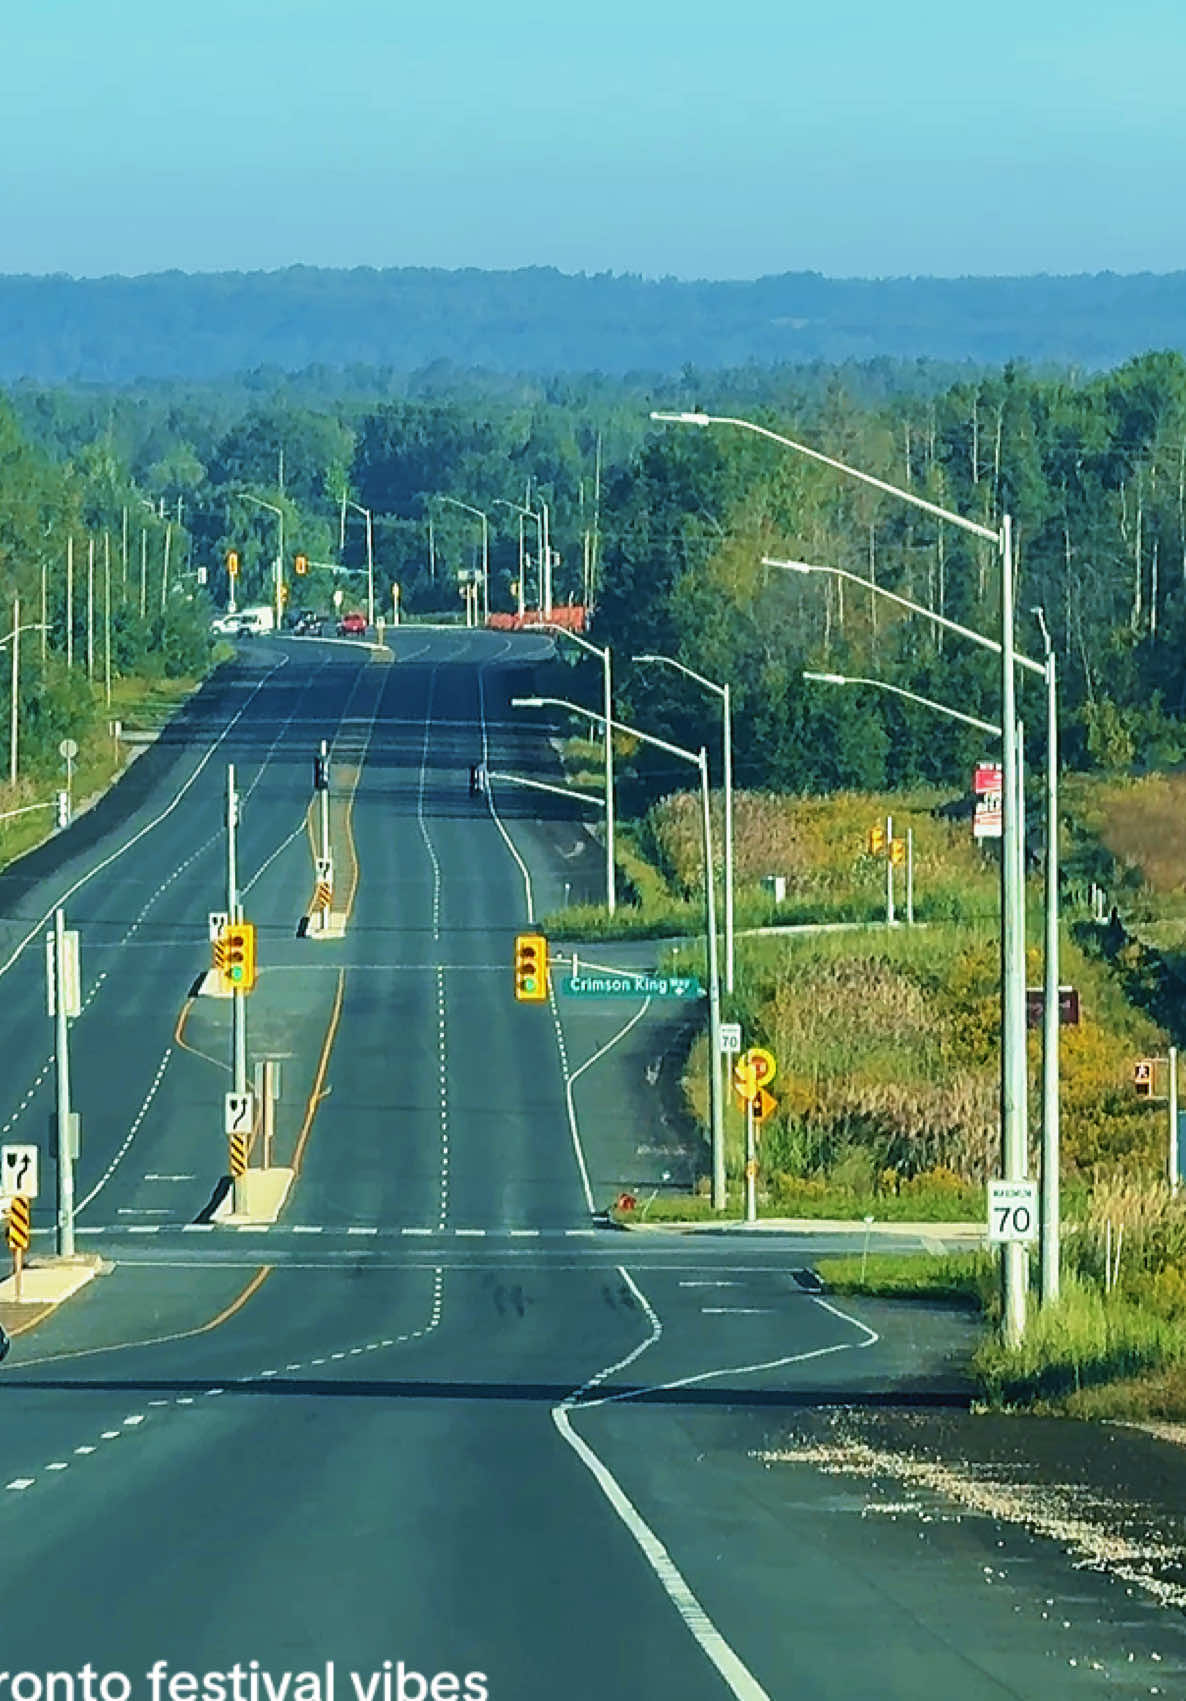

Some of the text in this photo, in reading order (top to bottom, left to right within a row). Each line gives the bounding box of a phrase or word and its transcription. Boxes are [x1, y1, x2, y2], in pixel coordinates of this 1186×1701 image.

[570, 978, 631, 992] Crimson
[635, 979, 668, 994] King
[721, 1035, 738, 1048] 70
[993, 1206, 1030, 1232] 70
